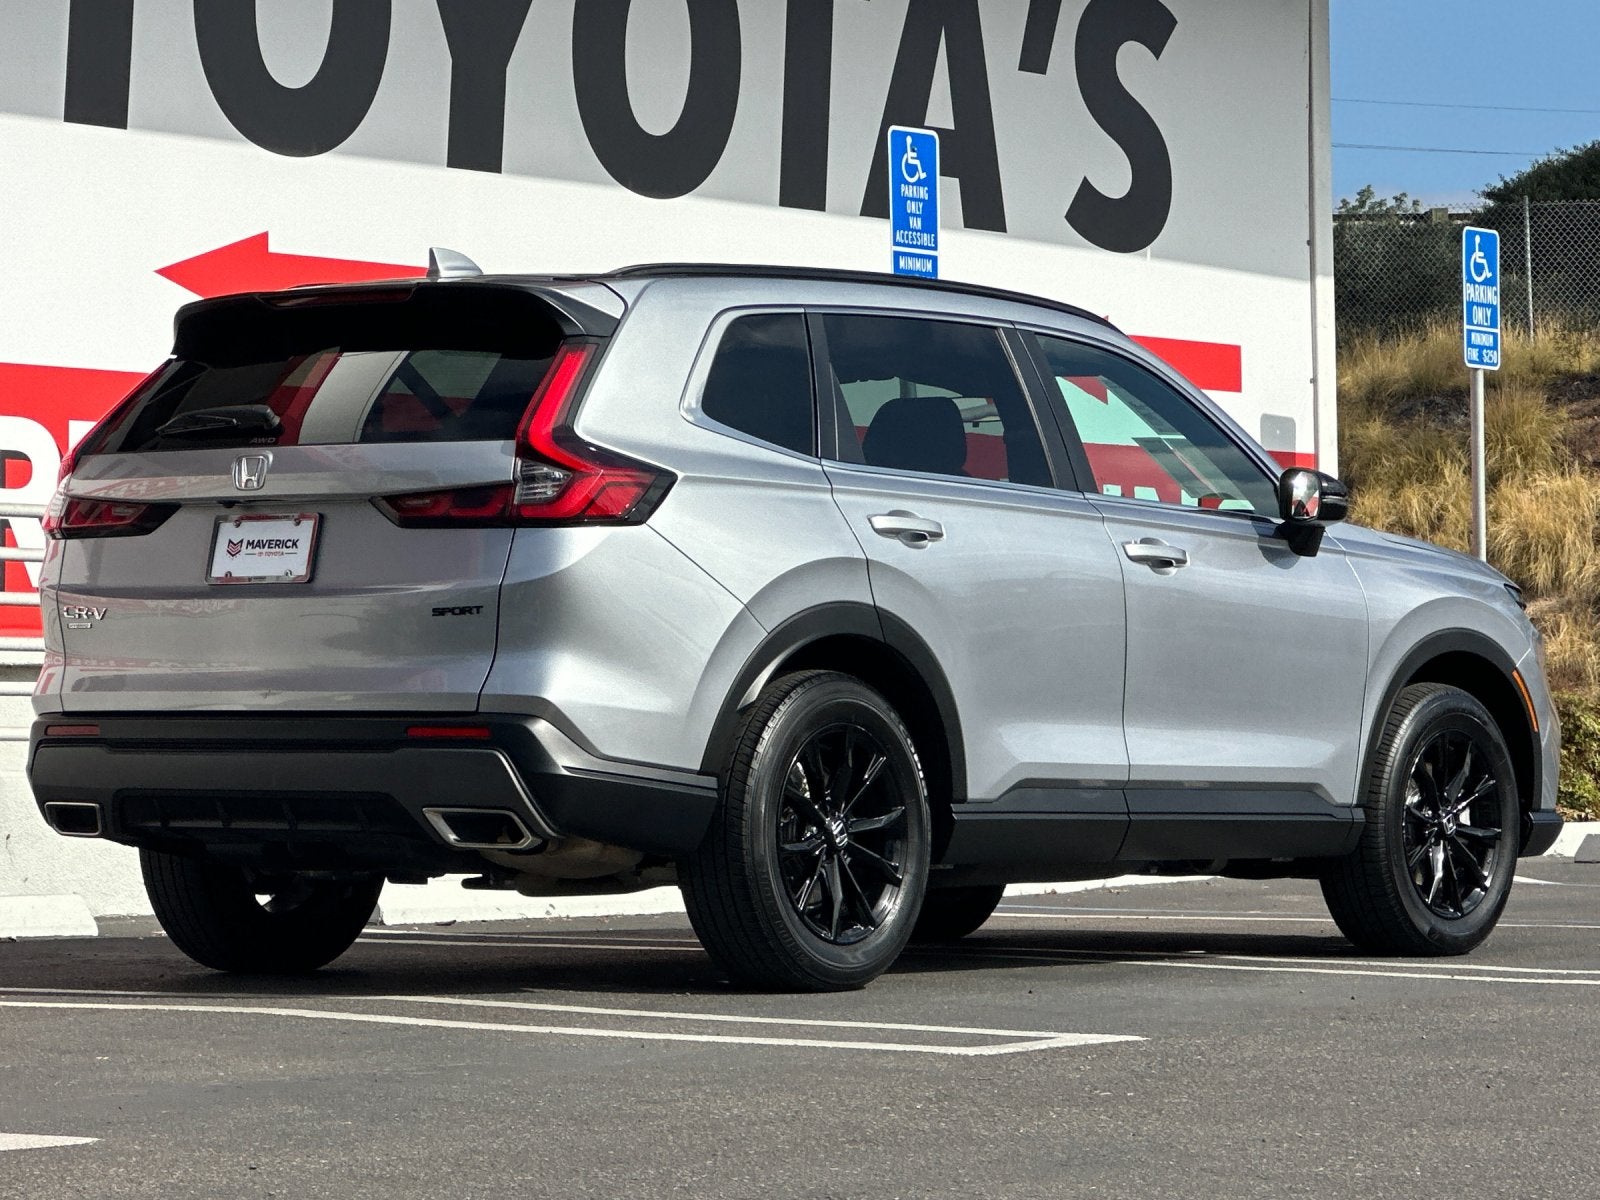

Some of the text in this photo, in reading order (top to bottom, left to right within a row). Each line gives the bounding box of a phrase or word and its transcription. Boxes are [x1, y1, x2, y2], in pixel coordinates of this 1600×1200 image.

[901, 184, 928, 200] PARKING
[906, 200, 923, 214] ONLY
[909, 216, 922, 230] VAN
[896, 229, 935, 247] ACCESSIBLE
[899, 256, 933, 273] MINIMUM
[1466, 283, 1497, 305] PARKING
[1472, 305, 1491, 326] ONLY
[245, 539, 300, 550] MAVERICK
[63, 605, 107, 620] CR-V
[432, 605, 484, 617] SPORT
